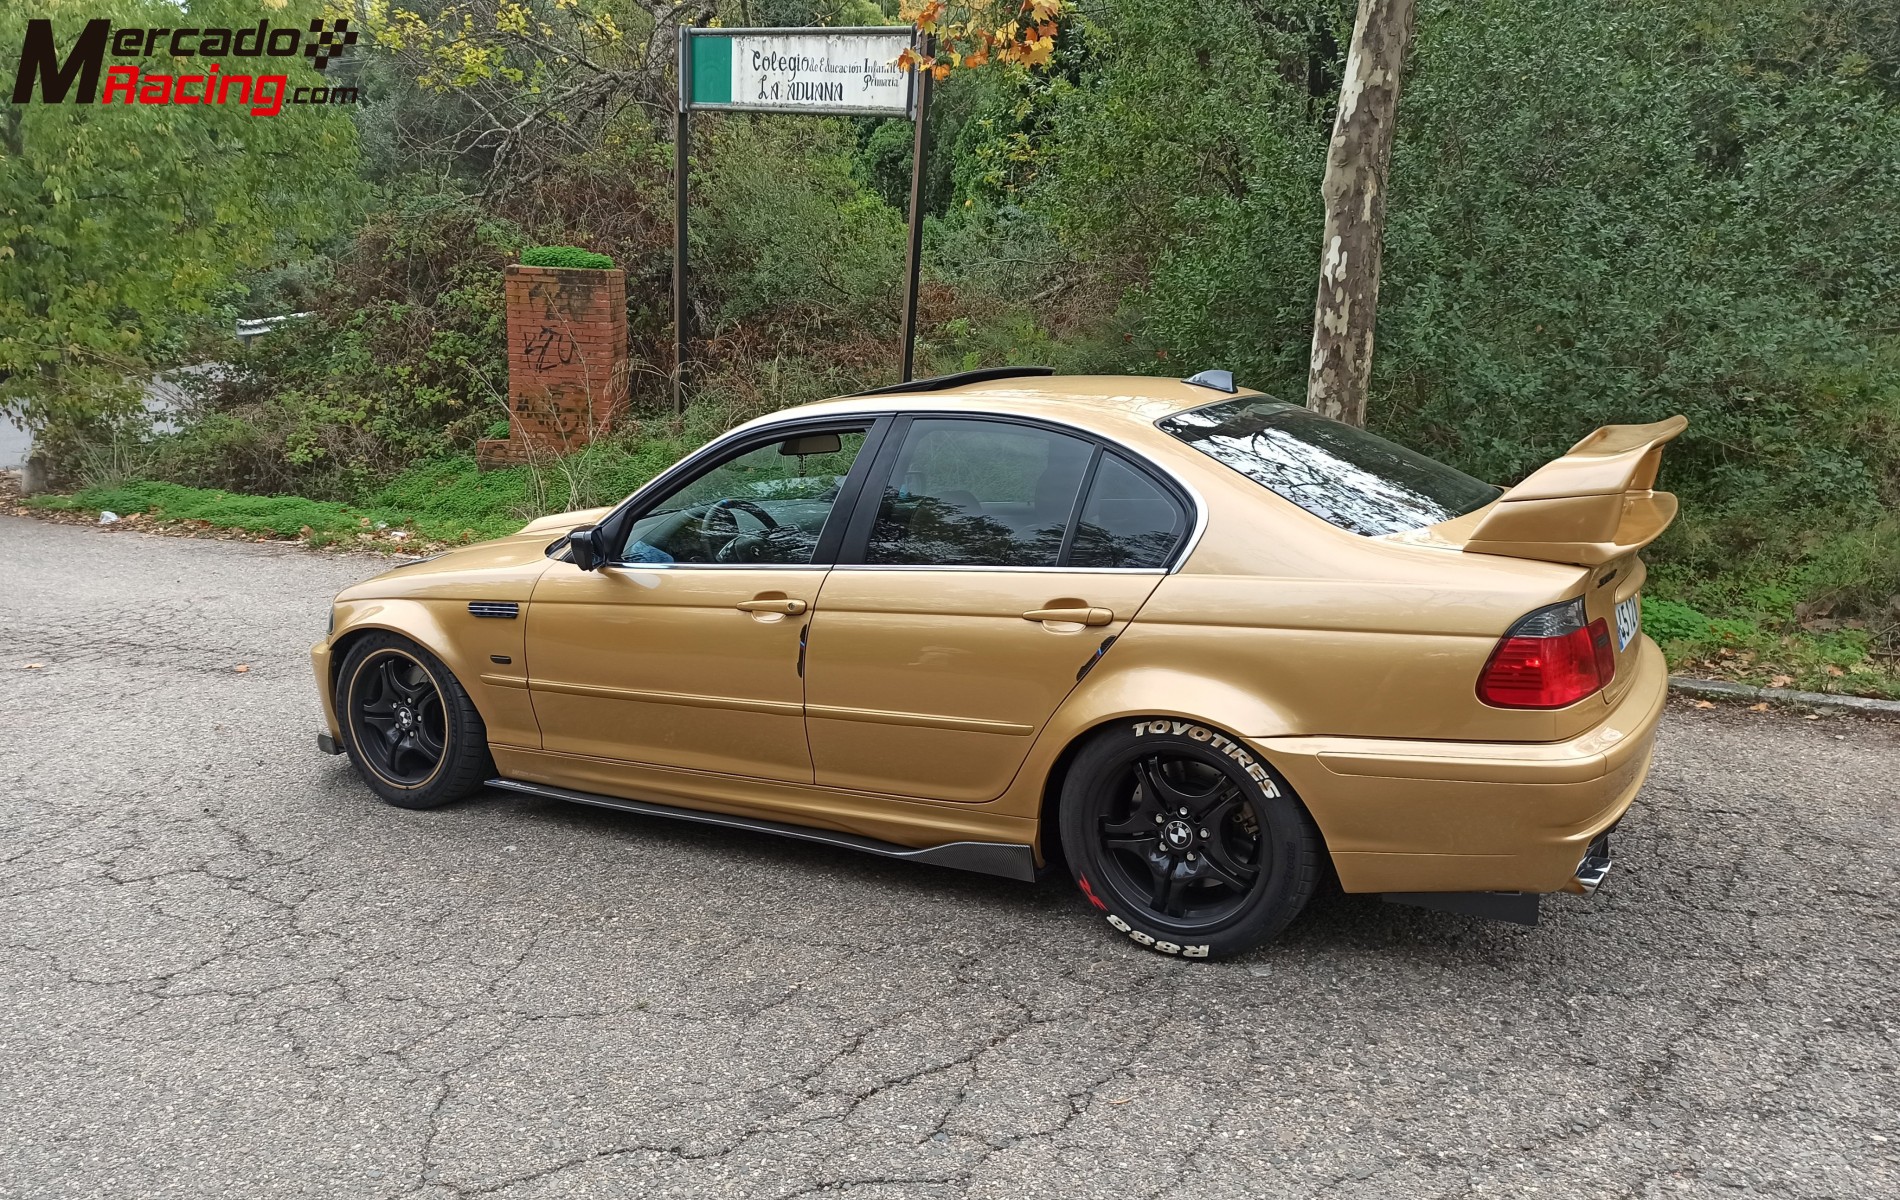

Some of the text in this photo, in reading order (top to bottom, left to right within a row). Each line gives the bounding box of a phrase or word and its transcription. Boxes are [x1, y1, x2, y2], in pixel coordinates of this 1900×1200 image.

[751, 49, 809, 82] Colegio
[809, 57, 819, 72] de
[787, 81, 843, 101] ADUANA
[862, 74, 899, 92] Primaria
